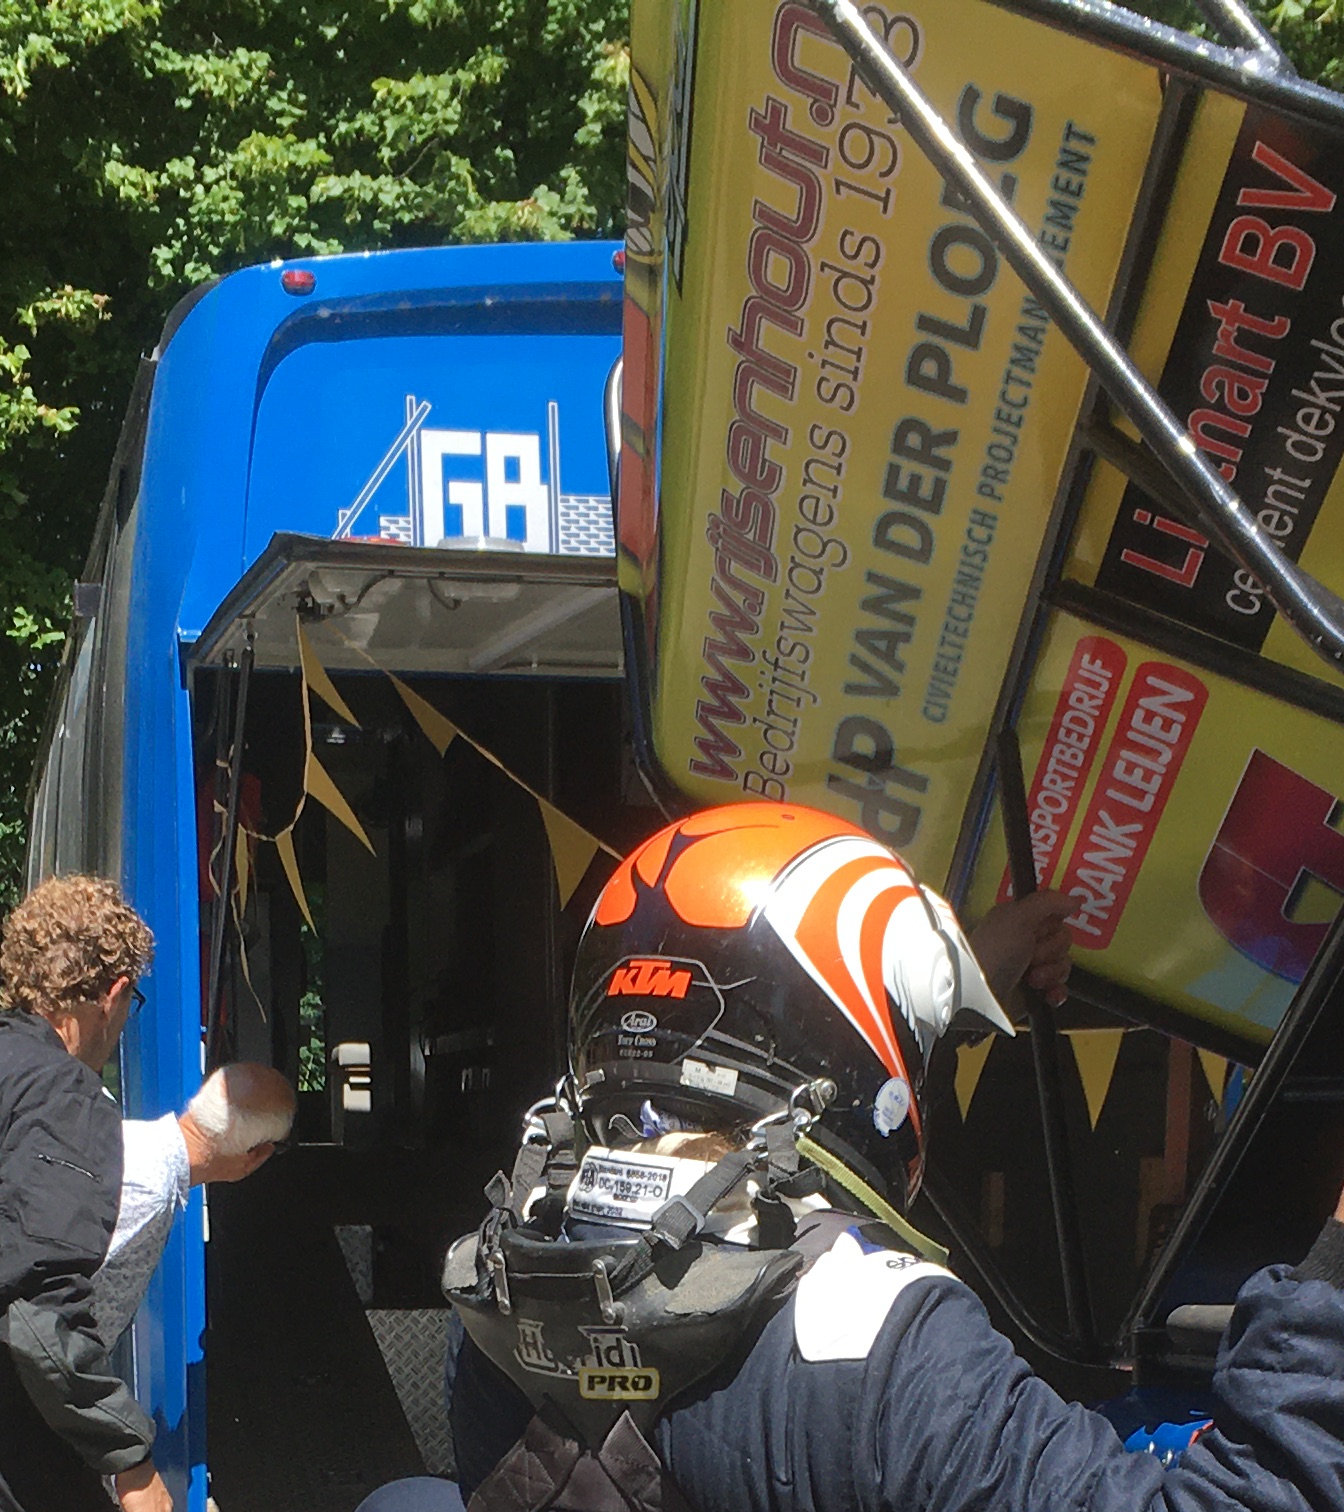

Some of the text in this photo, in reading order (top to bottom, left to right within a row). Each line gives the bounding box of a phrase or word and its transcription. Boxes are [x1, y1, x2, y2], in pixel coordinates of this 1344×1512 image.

[1217, 140, 1338, 292] BV
[688, 0, 842, 782] www.rijsenhout.n
[920, 119, 1099, 724] CIVIELTECHNISCH PROJECTMANEMENT
[742, 423, 849, 803] Bedrijfswagens
[807, 228, 881, 413] sinds
[871, 415, 960, 567] DER
[1225, 466, 1312, 616] ceent
[842, 569, 924, 699] VAN
[1006, 650, 1114, 898] ANSPORTBEDRIJF
[1063, 675, 1196, 937] FRANK LEIJEN
[607, 959, 693, 999] KTM
[587, 1374, 653, 1392] PRO
